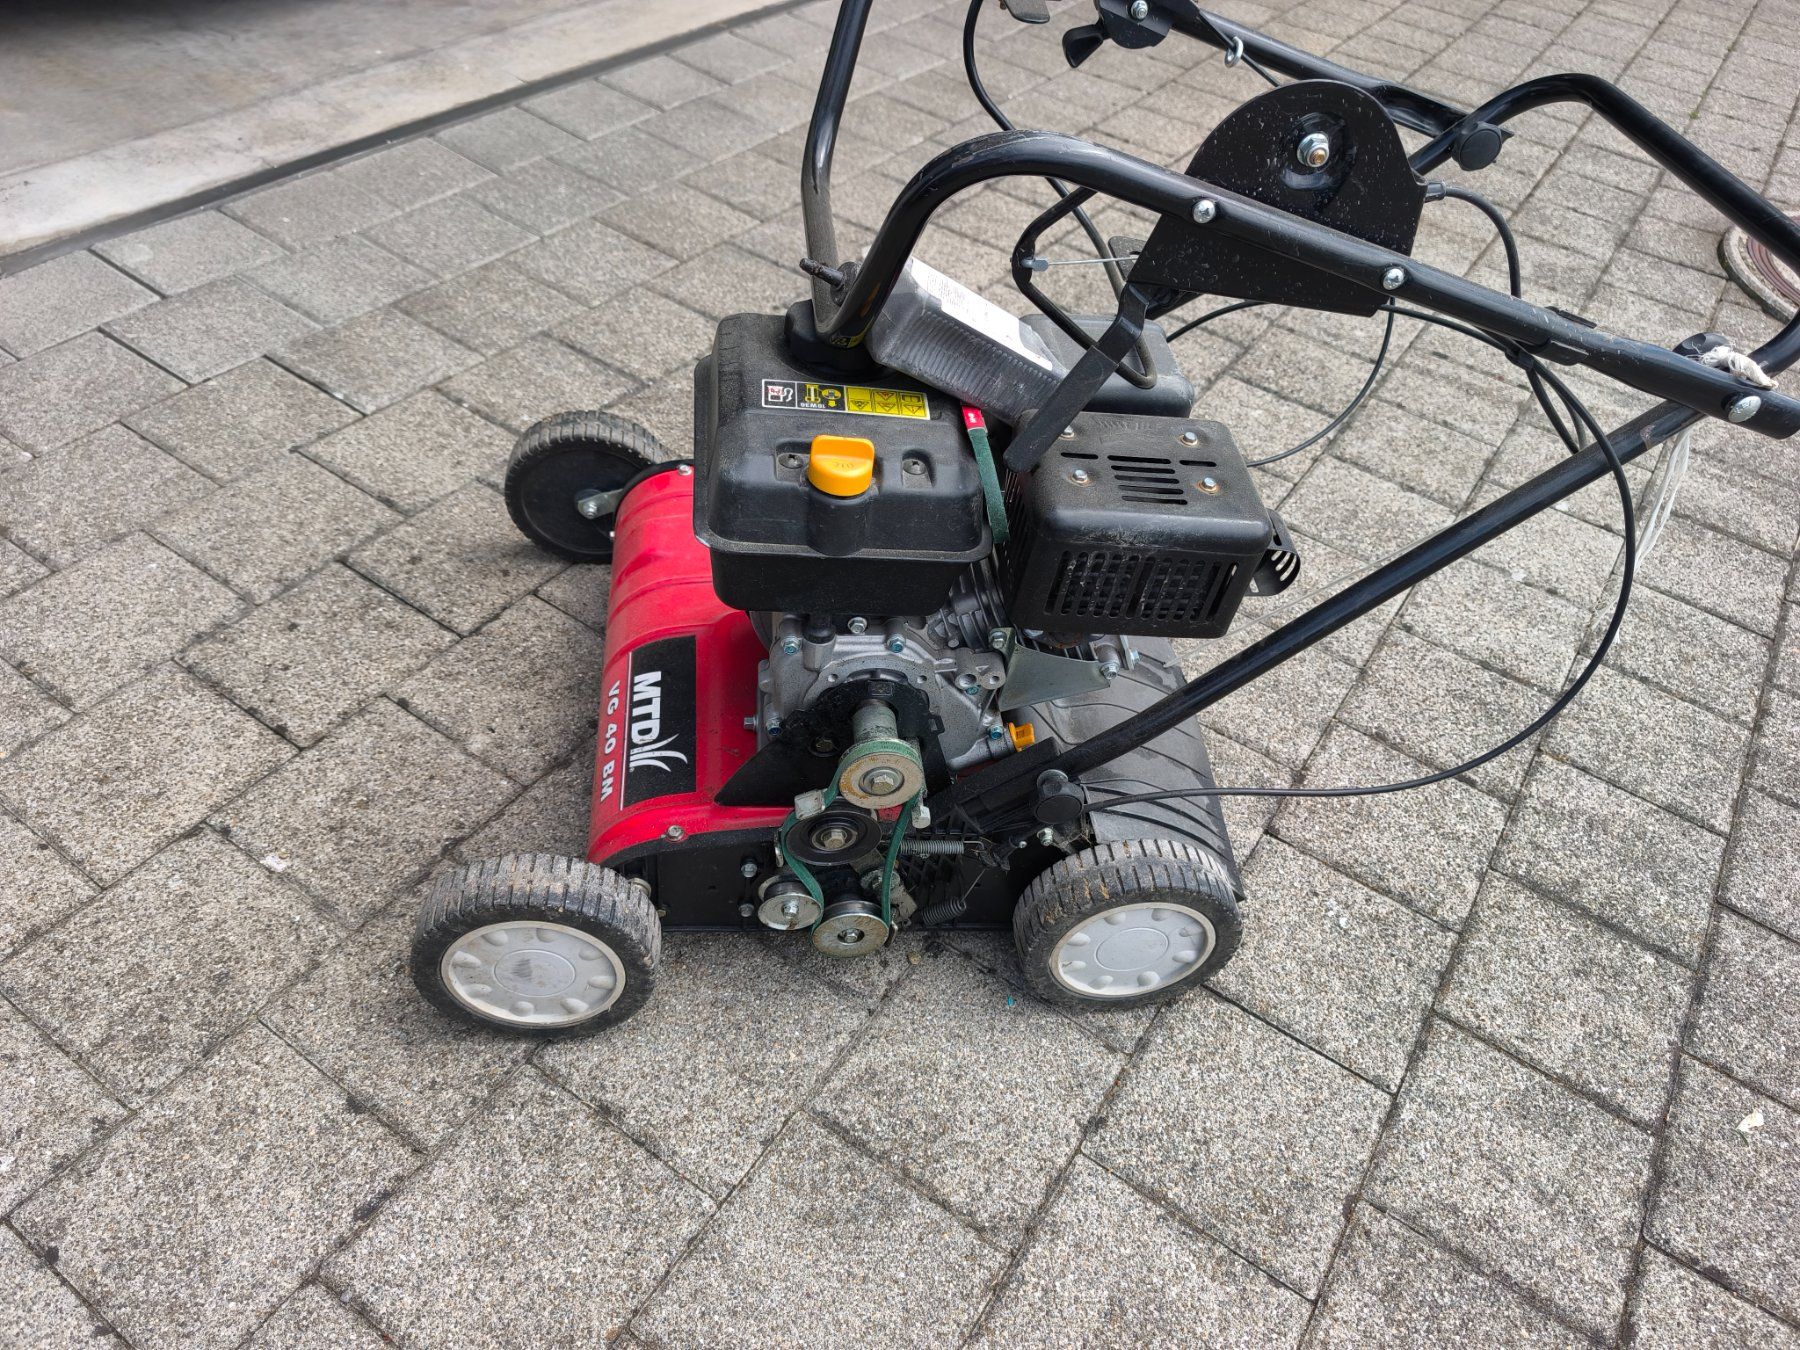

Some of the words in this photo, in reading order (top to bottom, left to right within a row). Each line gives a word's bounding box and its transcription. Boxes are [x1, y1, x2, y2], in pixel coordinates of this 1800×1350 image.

[607, 680, 621, 715] VG
[631, 671, 662, 745] MTD
[604, 723, 618, 755] 40
[600, 760, 615, 802] BM
